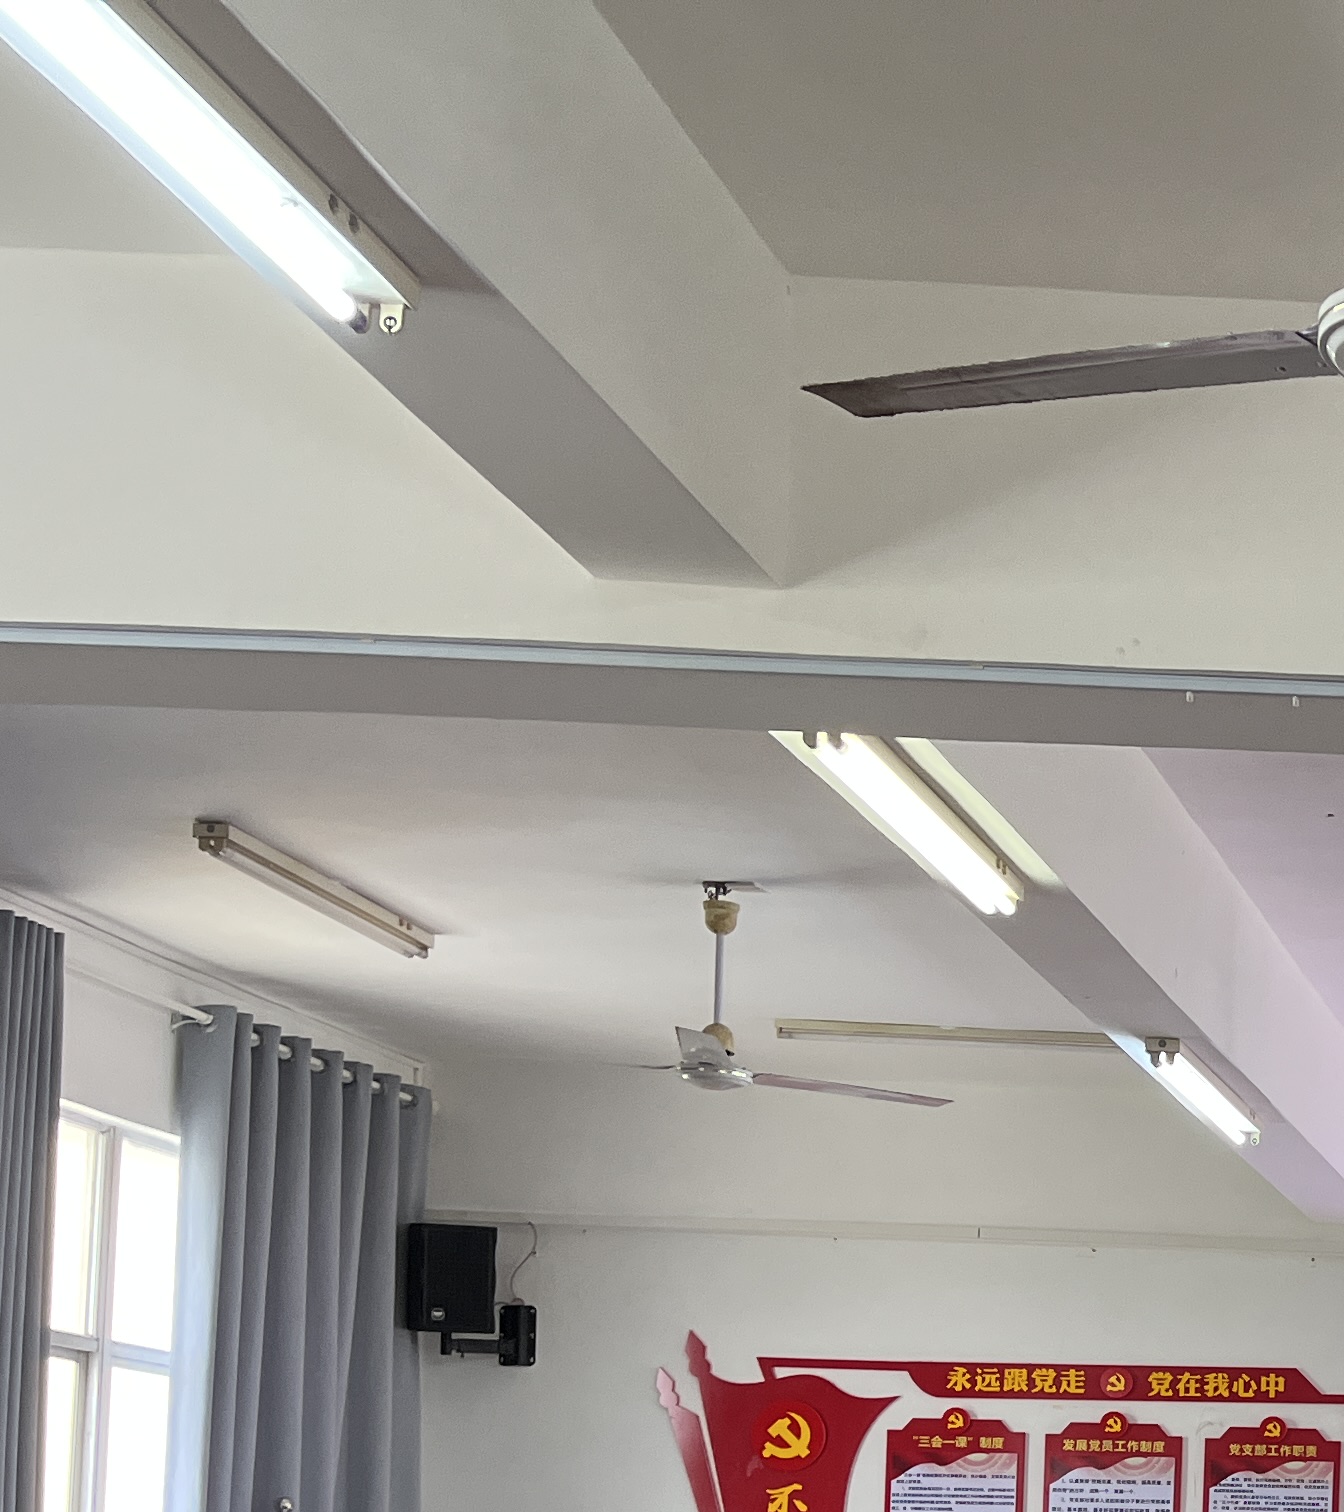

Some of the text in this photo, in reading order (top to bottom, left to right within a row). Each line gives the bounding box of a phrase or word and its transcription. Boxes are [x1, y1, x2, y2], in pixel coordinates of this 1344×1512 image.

[947, 1367, 1286, 1399] 永远跟党走 党在我心中
[1063, 1439, 1166, 1453] 发展党员工作制度
[1229, 1443, 1318, 1457] 党支部工作职责
